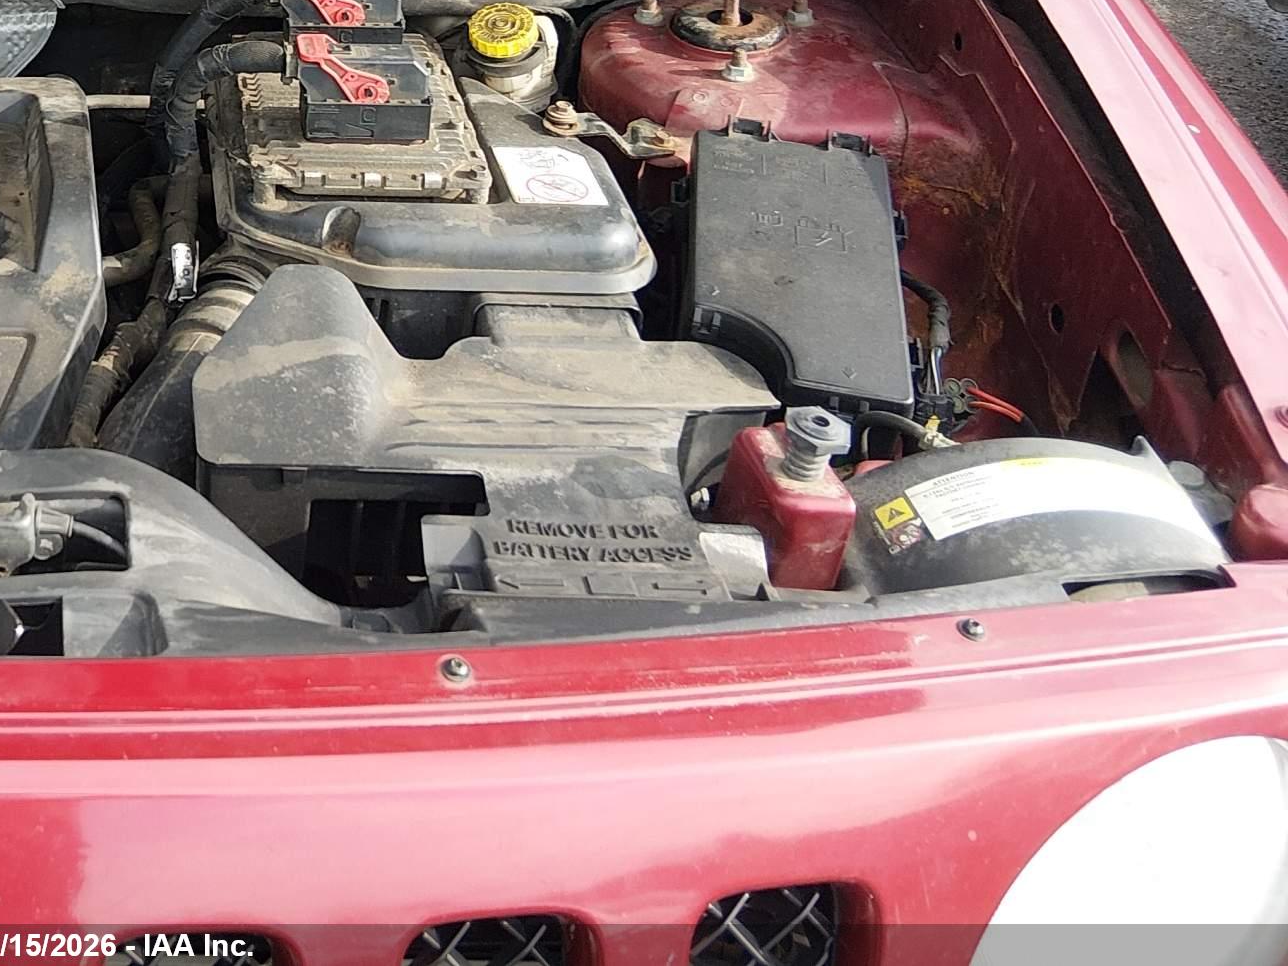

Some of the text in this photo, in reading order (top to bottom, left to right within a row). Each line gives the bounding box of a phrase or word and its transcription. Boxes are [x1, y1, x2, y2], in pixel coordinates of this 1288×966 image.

[506, 519, 660, 540] REMOVE FOR
[493, 541, 693, 563] BATTERY ACCESS
